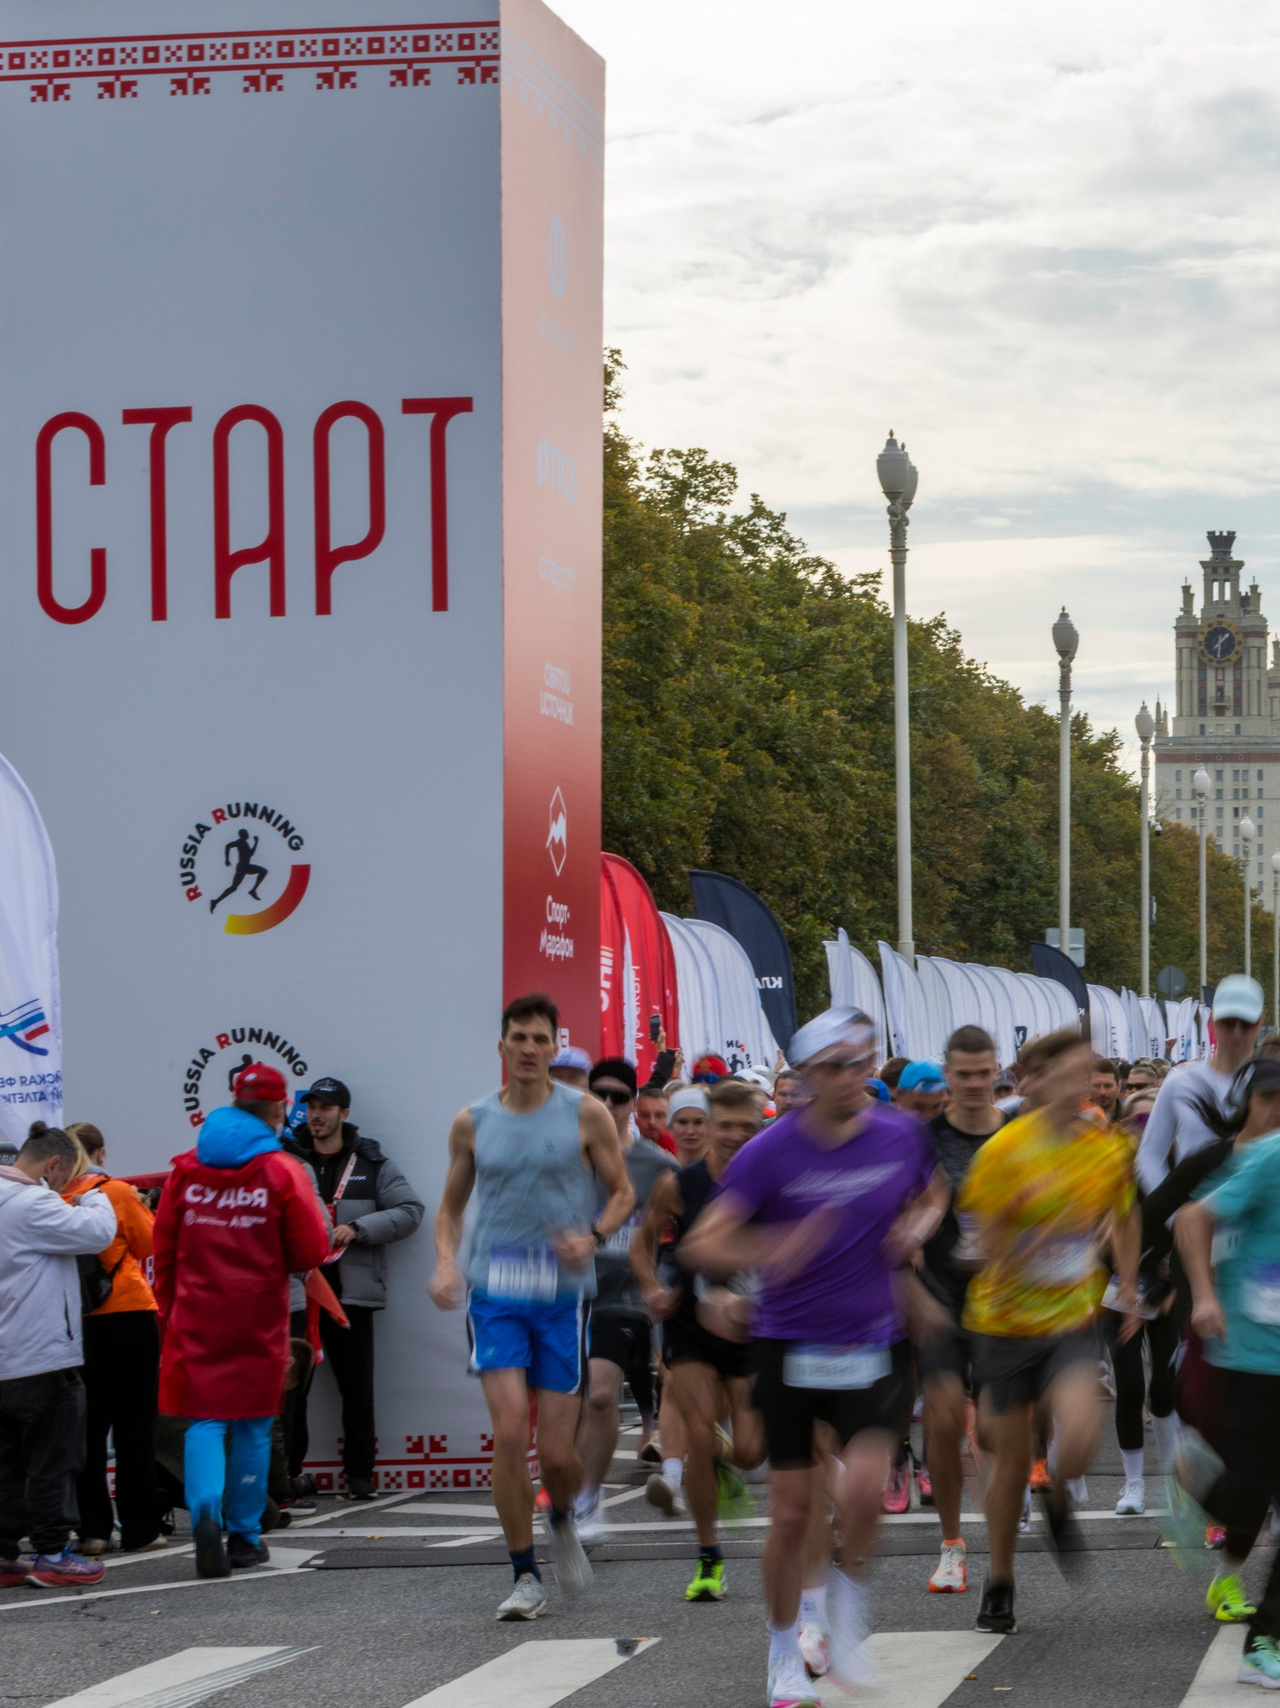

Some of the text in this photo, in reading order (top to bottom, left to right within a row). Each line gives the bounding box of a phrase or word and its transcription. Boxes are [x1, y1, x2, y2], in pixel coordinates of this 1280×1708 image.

[35, 396, 474, 625] СТАРТ
[179, 801, 304, 902] RUSSIA RUNNING
[539, 926, 574, 961] Марафон
[183, 1027, 309, 1128] RUSSIA RUNNING
[184, 1183, 269, 1209] СУДЬЯ
